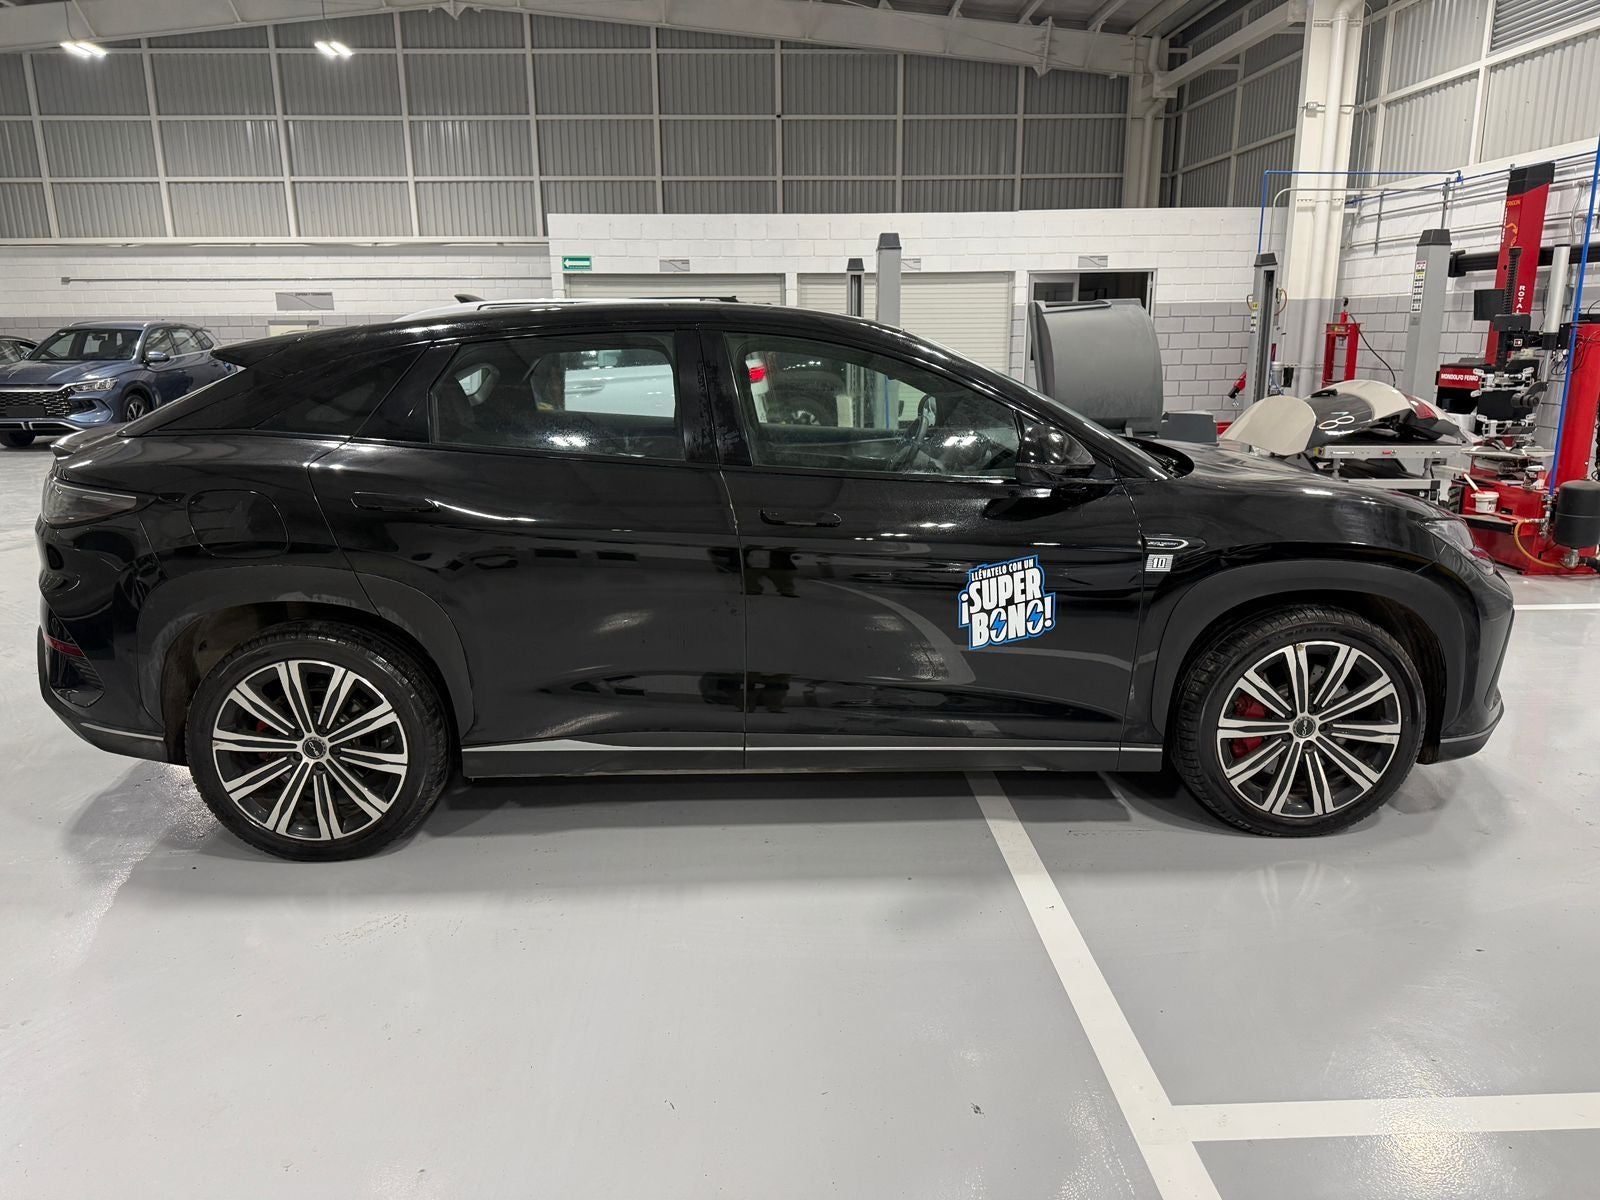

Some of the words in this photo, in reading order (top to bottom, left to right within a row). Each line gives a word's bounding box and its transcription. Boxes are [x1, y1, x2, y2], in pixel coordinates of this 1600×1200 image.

[971, 565, 1007, 582] LLÉVATELO
[1008, 560, 1023, 573] CON
[1024, 558, 1034, 570] UN
